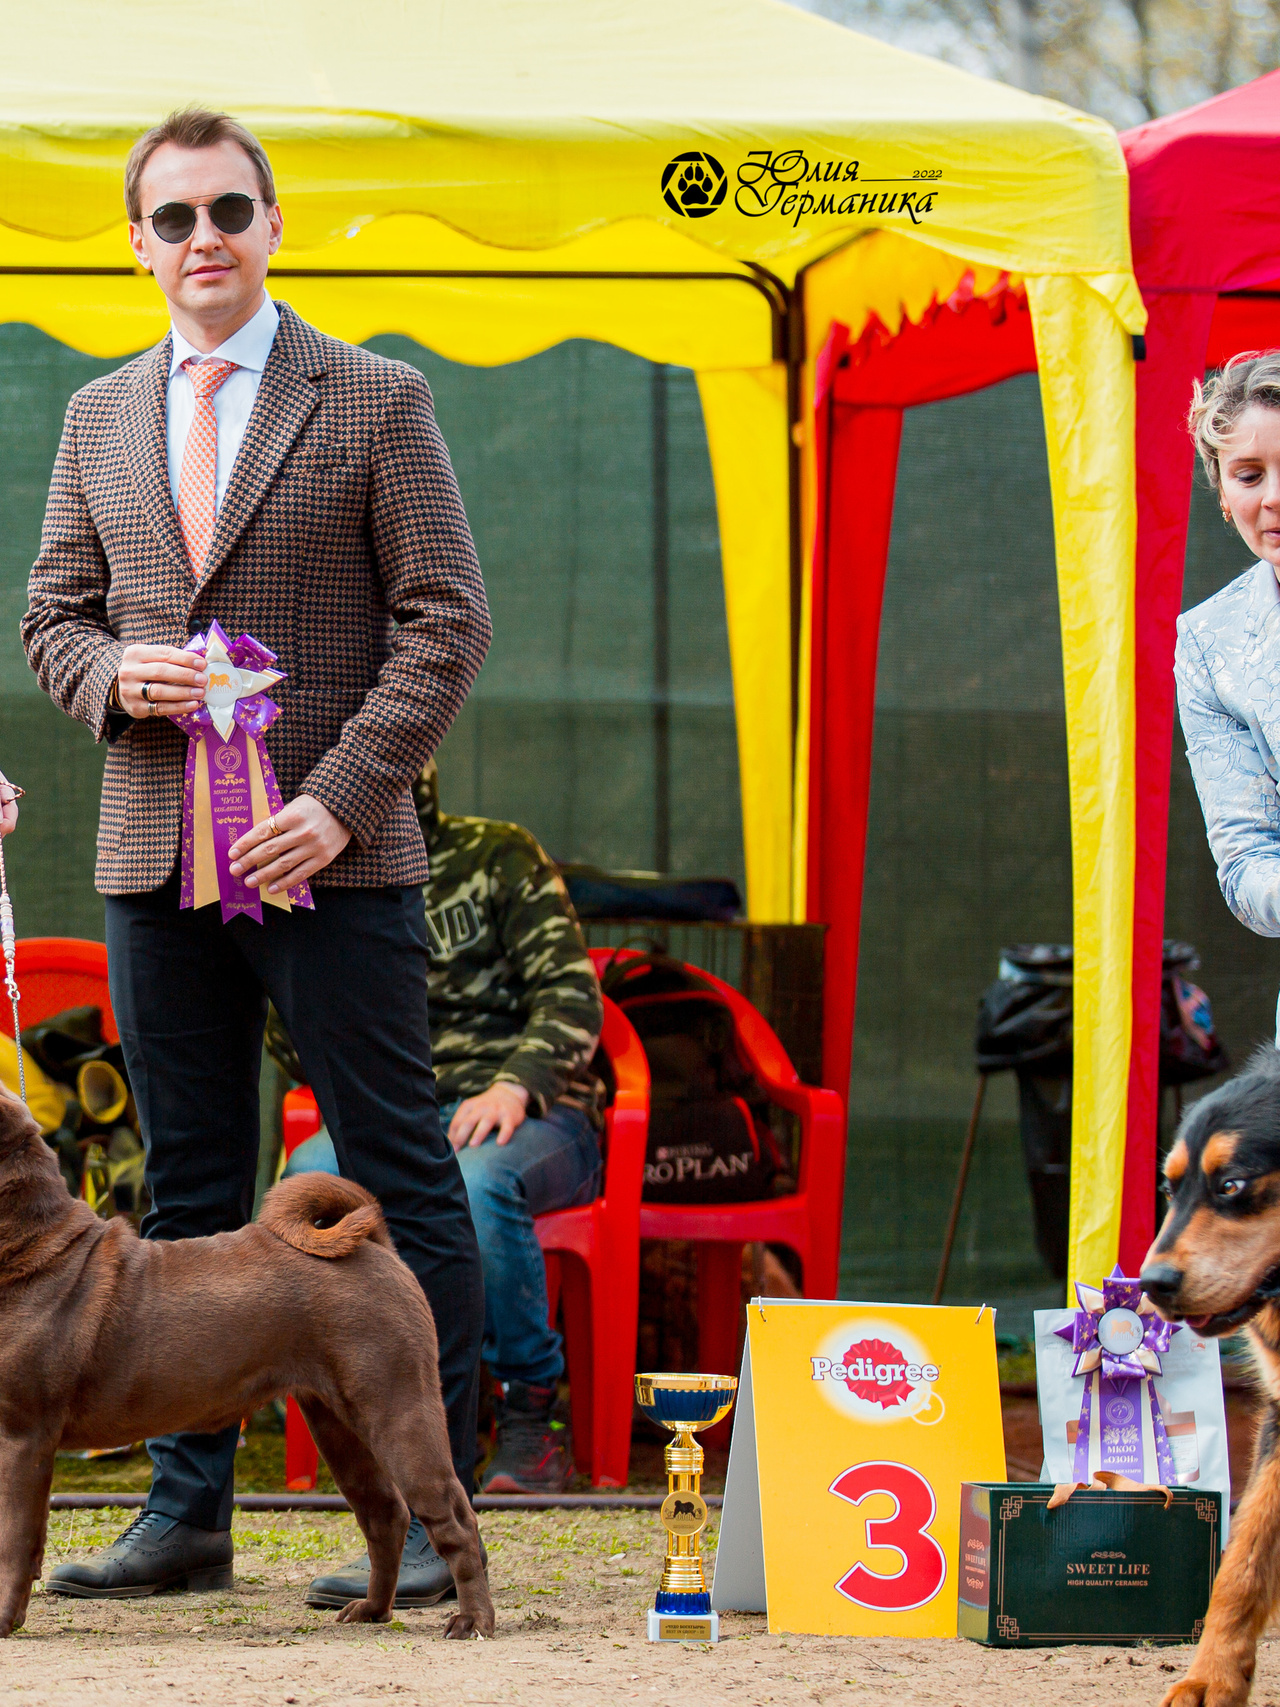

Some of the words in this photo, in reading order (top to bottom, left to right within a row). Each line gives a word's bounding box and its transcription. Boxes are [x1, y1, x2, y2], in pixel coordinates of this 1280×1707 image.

[810, 1356, 940, 1386] Pedigree
[828, 1460, 947, 1612] 3
[1066, 1563, 1116, 1575] SWEET
[1118, 1563, 1151, 1575] LIFE
